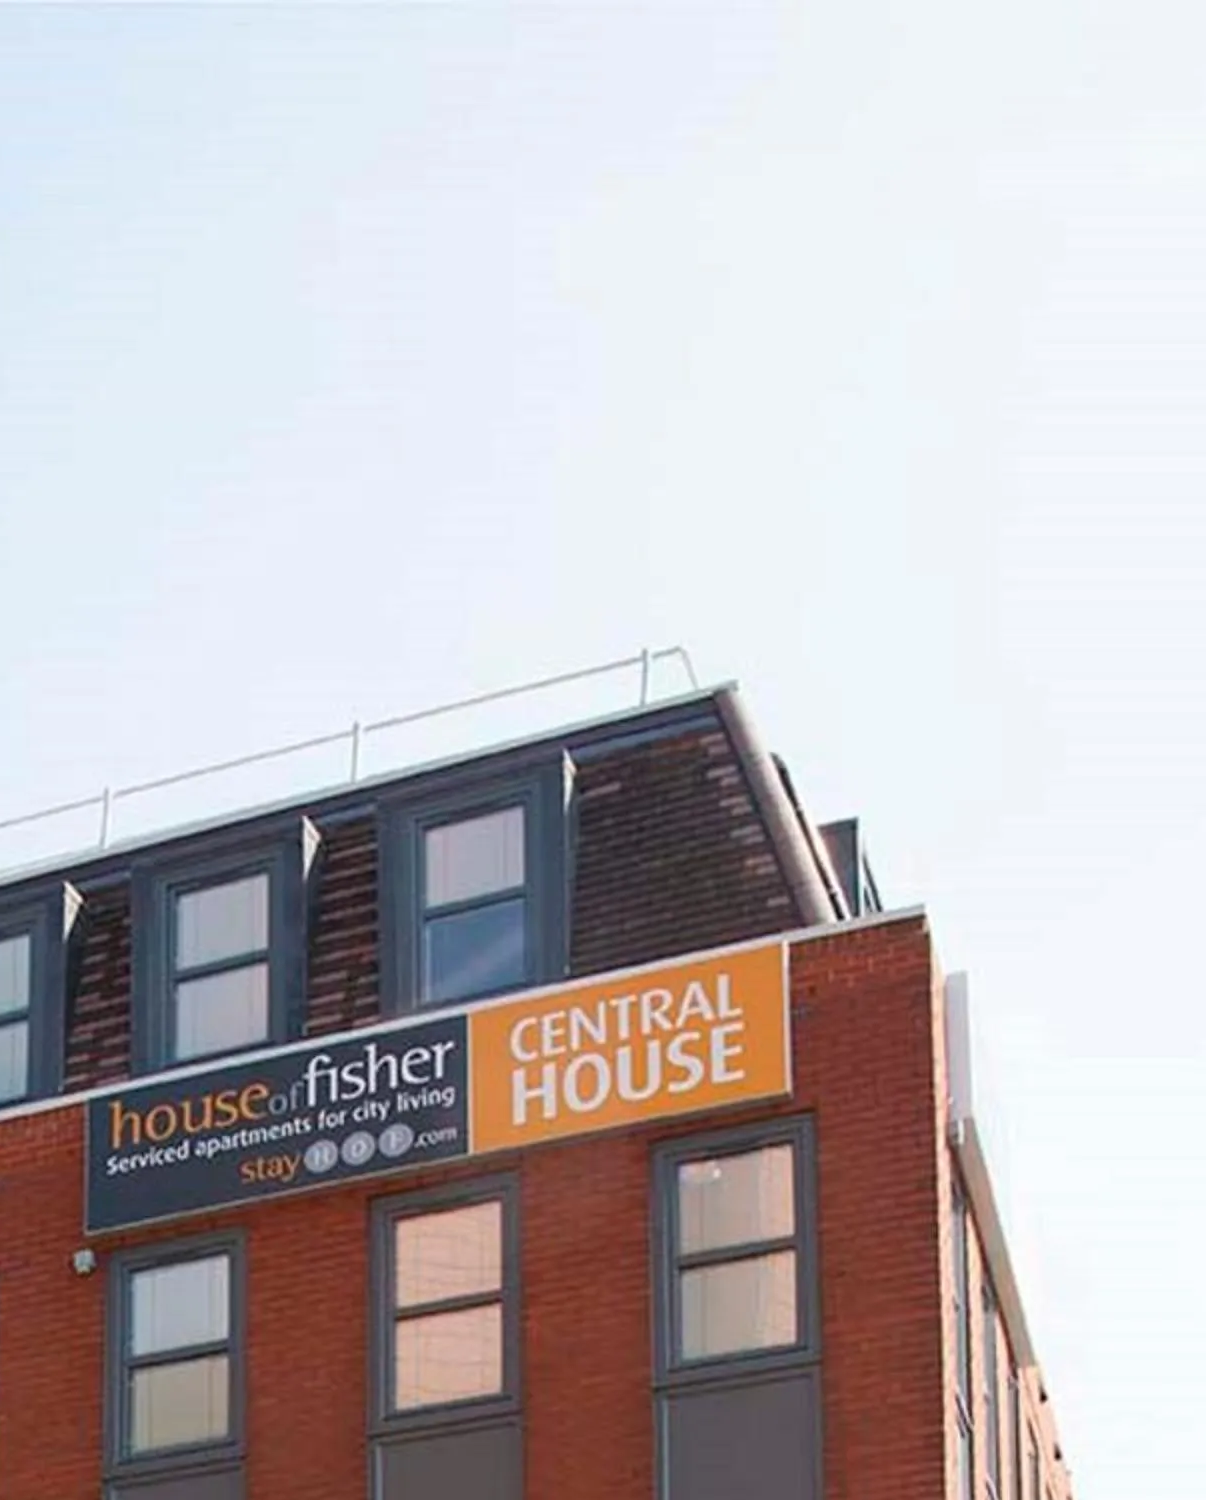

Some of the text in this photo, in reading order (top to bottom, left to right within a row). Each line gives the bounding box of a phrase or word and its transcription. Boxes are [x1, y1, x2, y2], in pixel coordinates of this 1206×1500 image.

[510, 973, 744, 1062] CENTRAL
[107, 1081, 271, 1150] house
[302, 1040, 455, 1108] fisher
[511, 1022, 746, 1126] HOUSE
[106, 1085, 456, 1175] Serviced apartments for city living
